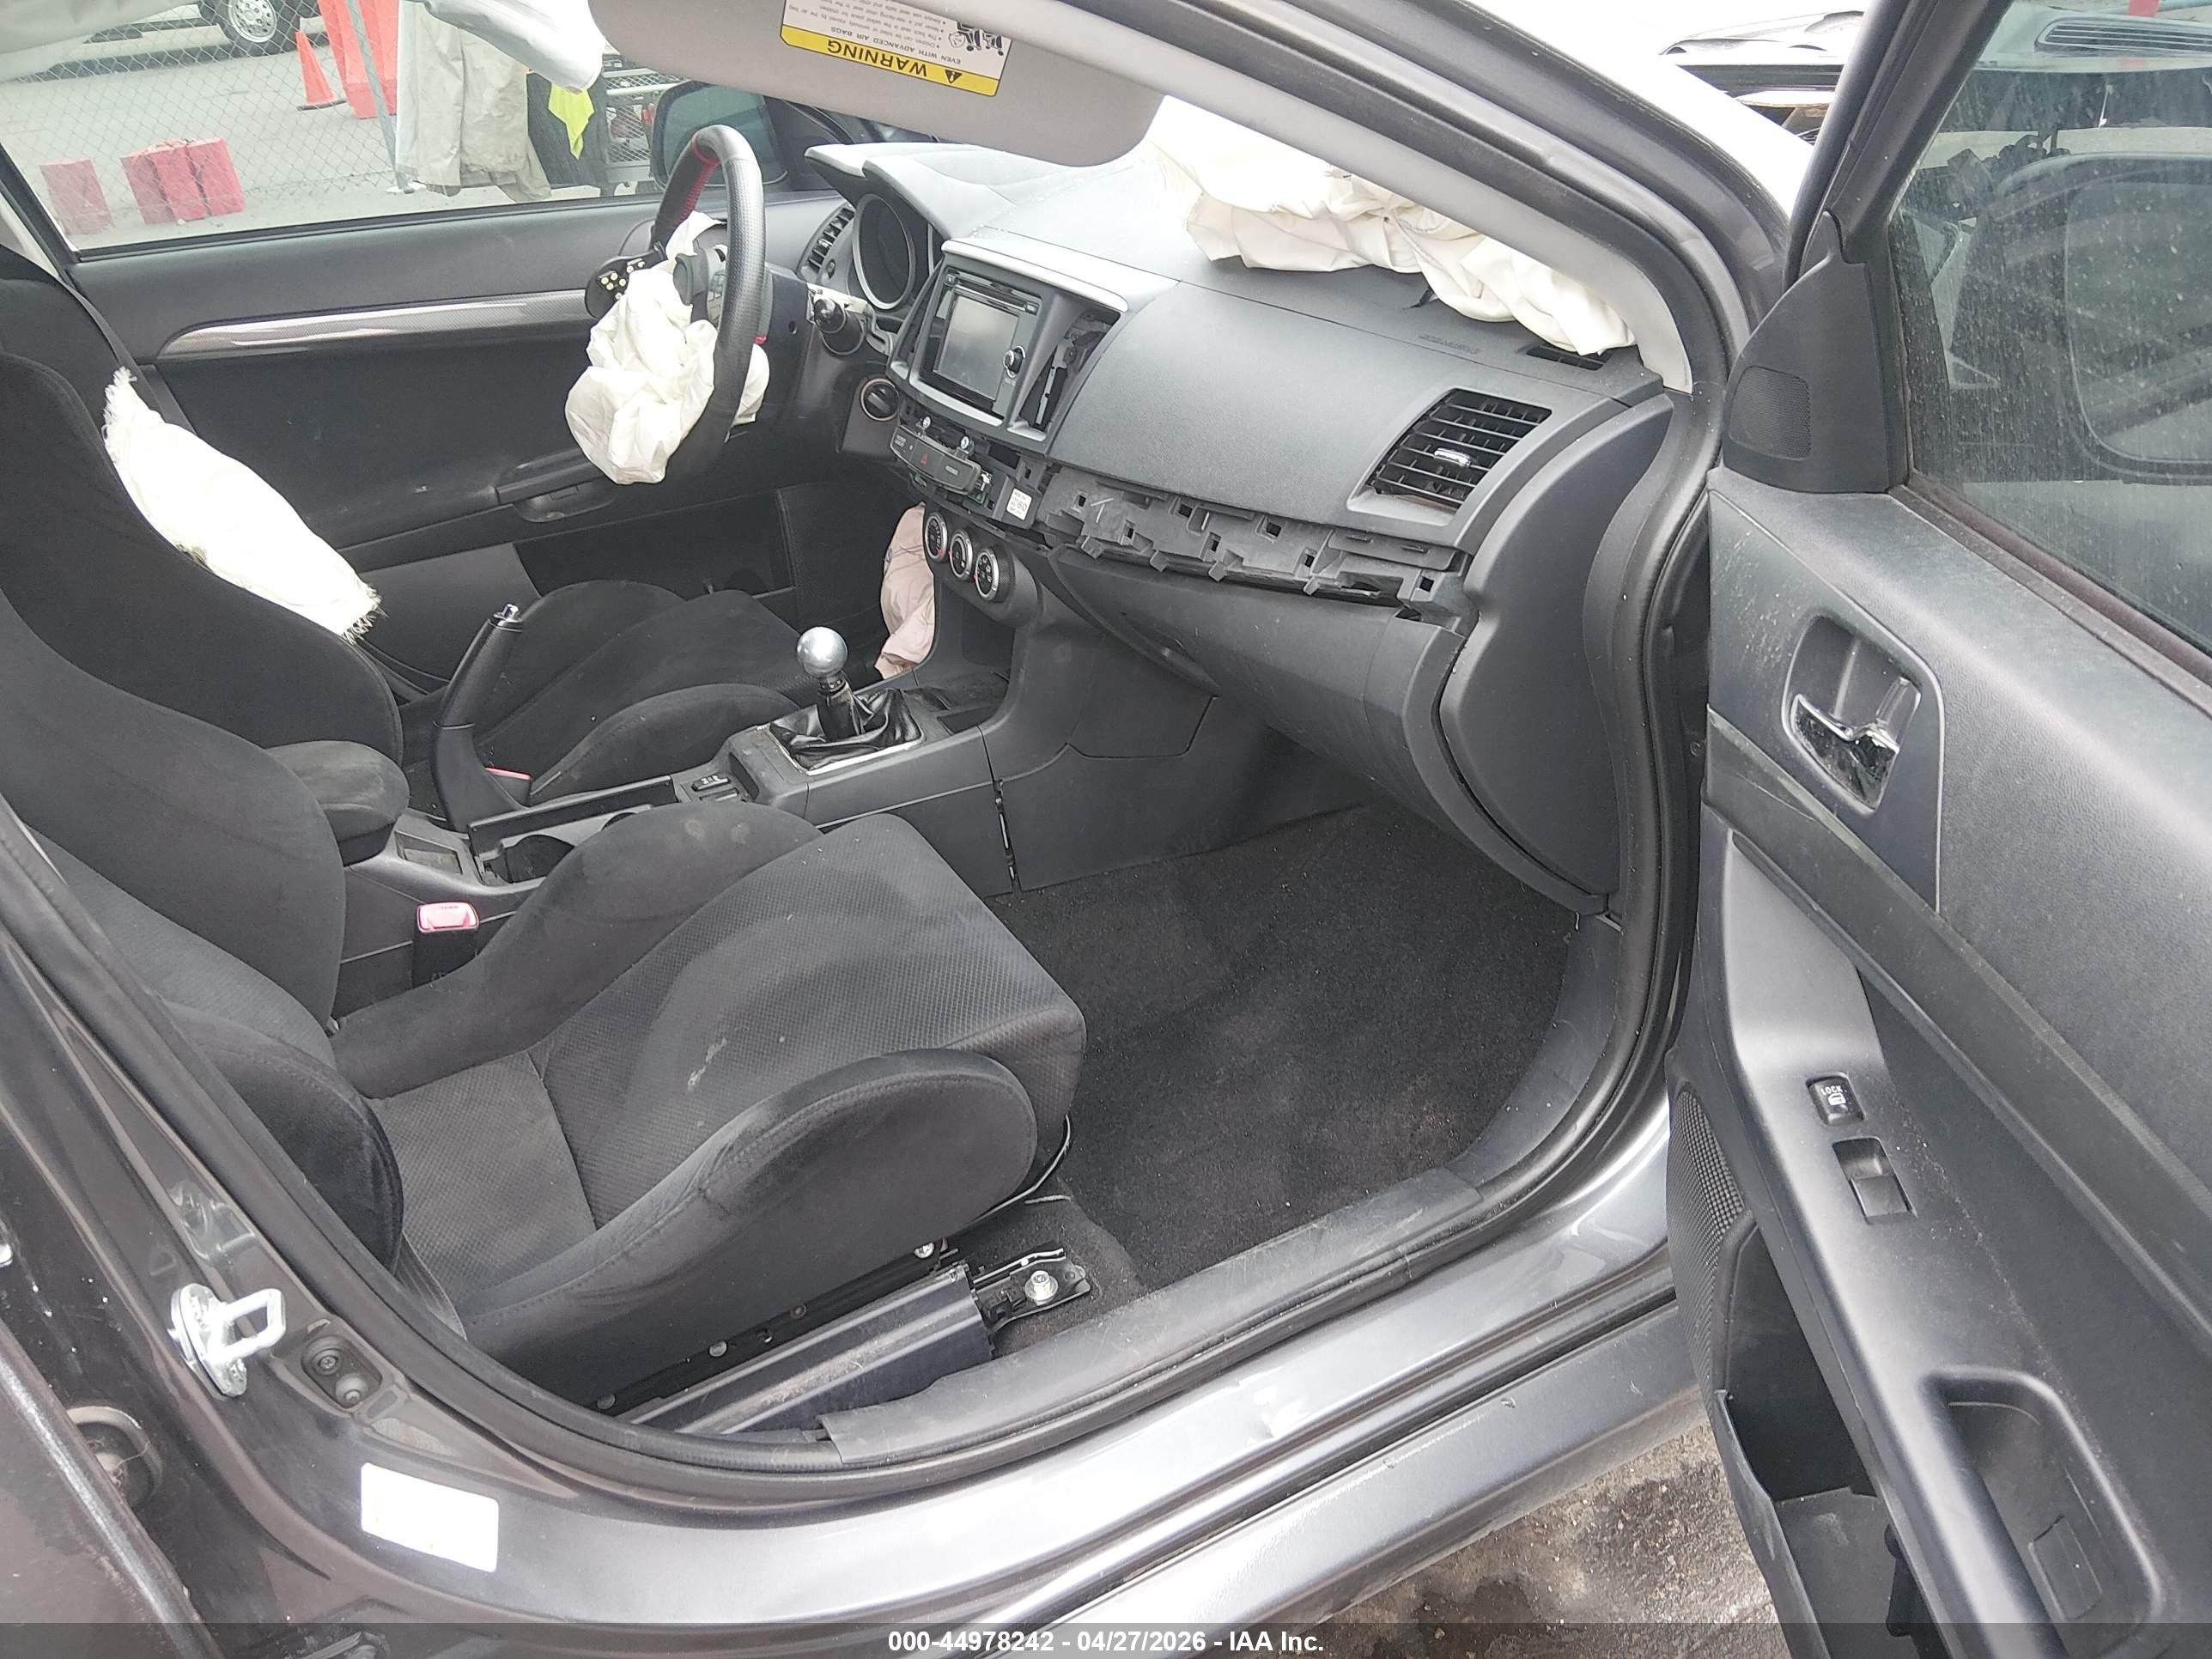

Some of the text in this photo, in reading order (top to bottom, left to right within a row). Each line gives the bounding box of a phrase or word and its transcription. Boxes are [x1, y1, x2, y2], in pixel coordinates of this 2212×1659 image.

[830, 26, 853, 37] BAGS
[872, 37, 915, 52] ADVANCED
[825, 39, 928, 76] WARNING
[918, 49, 938, 58] WITH
[940, 54, 961, 64] EVEN
[1820, 1085, 1844, 1096] LOCK
